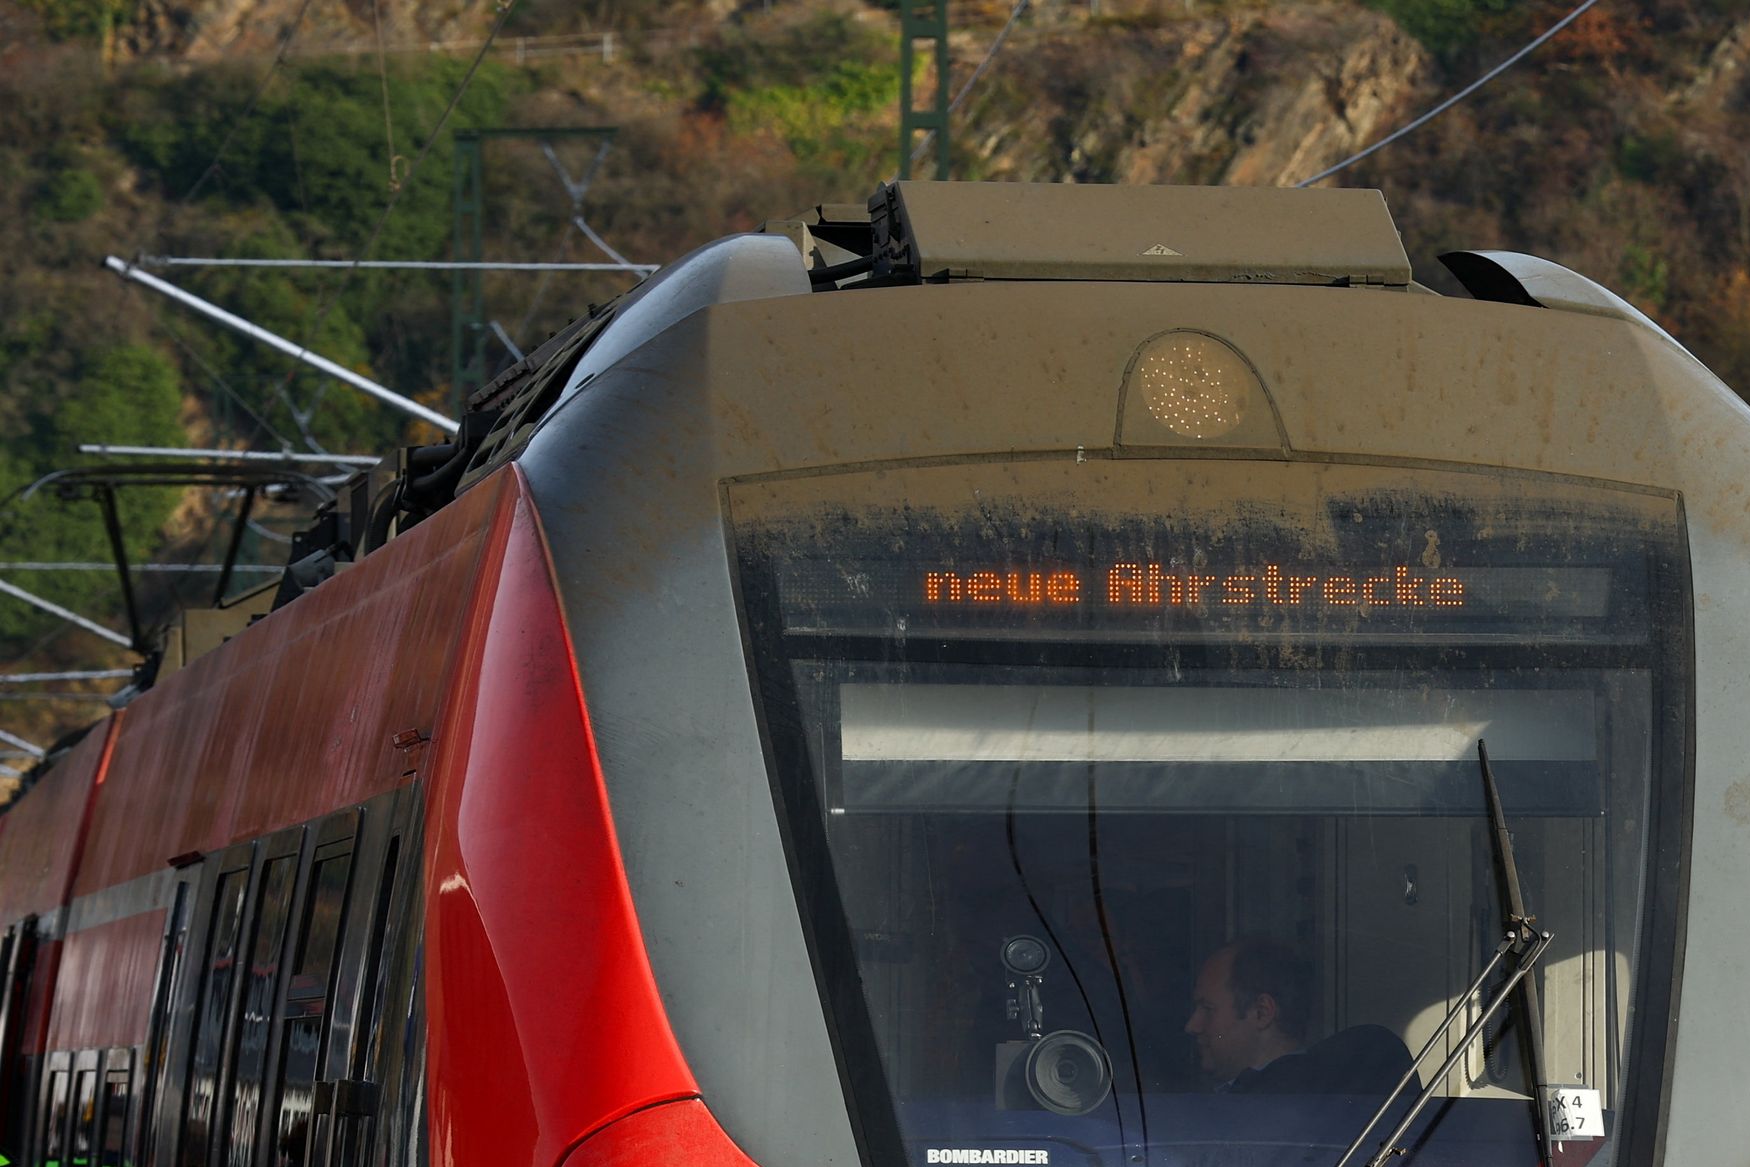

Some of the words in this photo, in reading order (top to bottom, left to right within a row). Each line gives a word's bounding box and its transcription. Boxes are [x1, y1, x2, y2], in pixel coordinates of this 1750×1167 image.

[927, 572, 1080, 602] neue
[1108, 563, 1464, 605] Ahrstrecke
[927, 1149, 1049, 1165] BOMBARDIER
